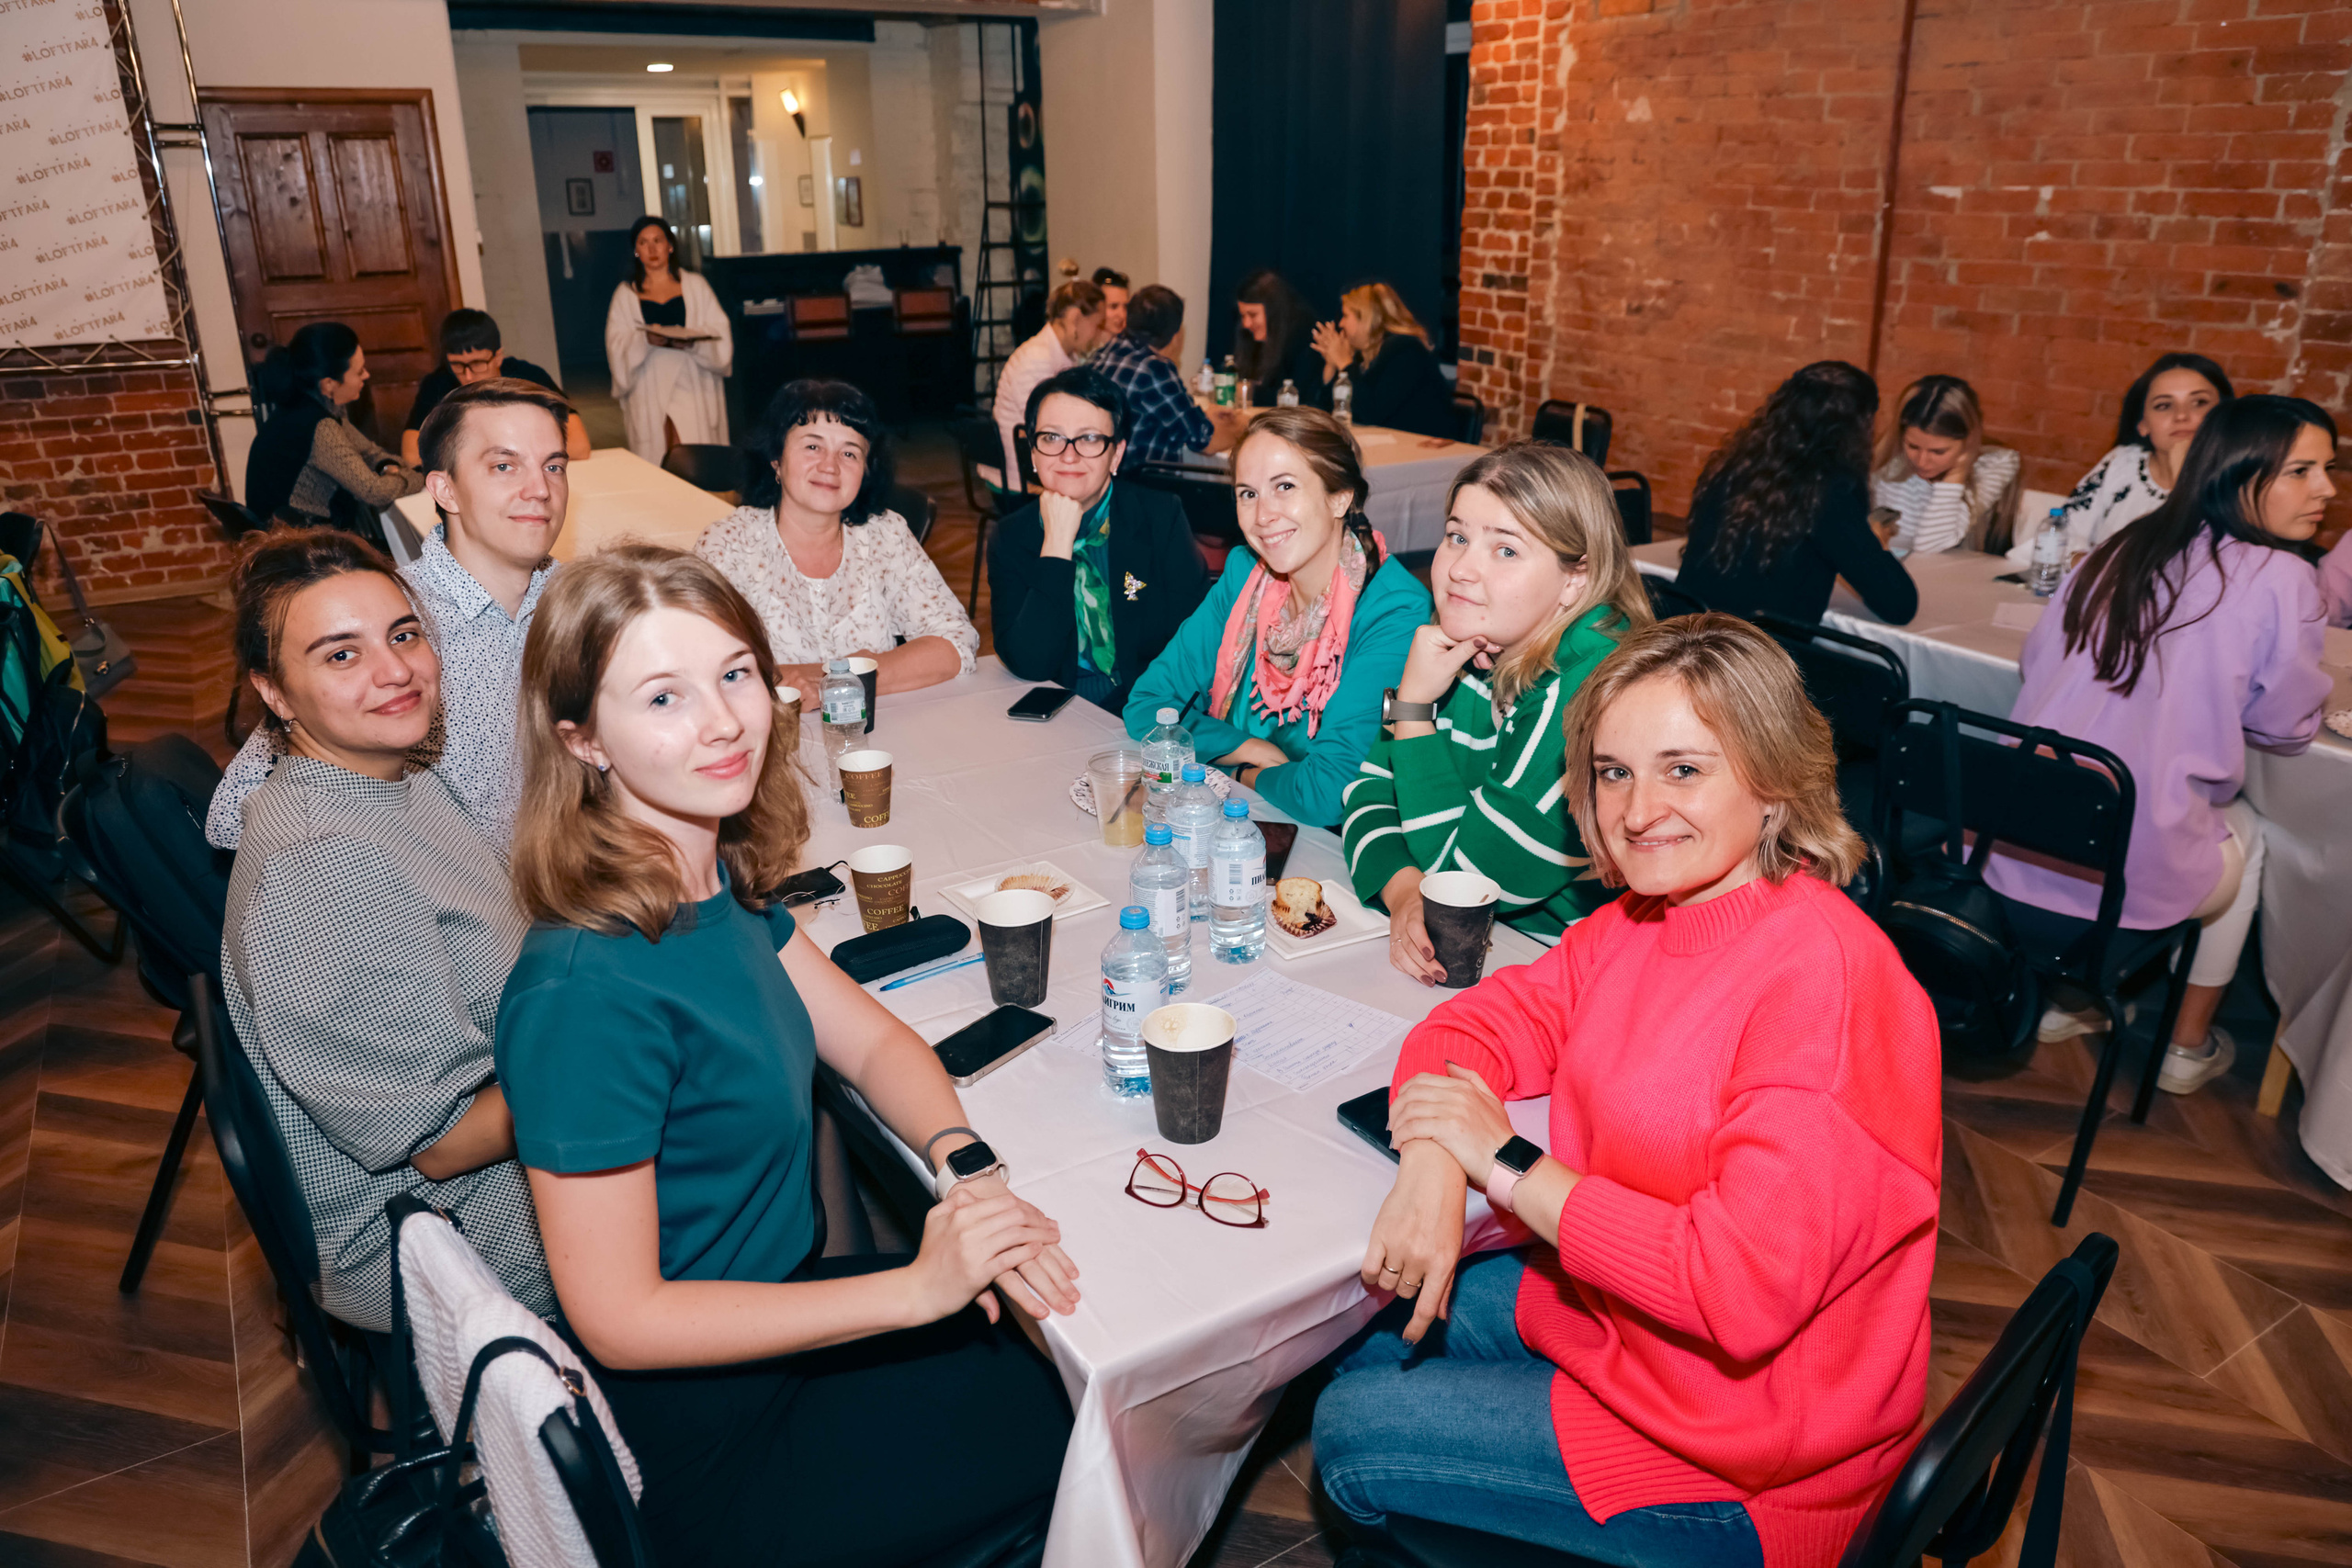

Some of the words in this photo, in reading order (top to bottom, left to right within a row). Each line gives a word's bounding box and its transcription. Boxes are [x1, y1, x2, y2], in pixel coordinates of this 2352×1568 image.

[22, 36, 98, 62] #LOFTFAR4
[48, 118, 122, 146] #LOFTFAR4
[17, 157, 91, 185] #LOFTFAR4
[66, 197, 139, 225] #LOFTFAR4
[35, 235, 108, 264] #LOFTFAR4
[84, 275, 155, 303] #LOFTFAR4
[54, 311, 125, 341] #LOFTFAR4
[866, 904, 904, 916] COFFEE
